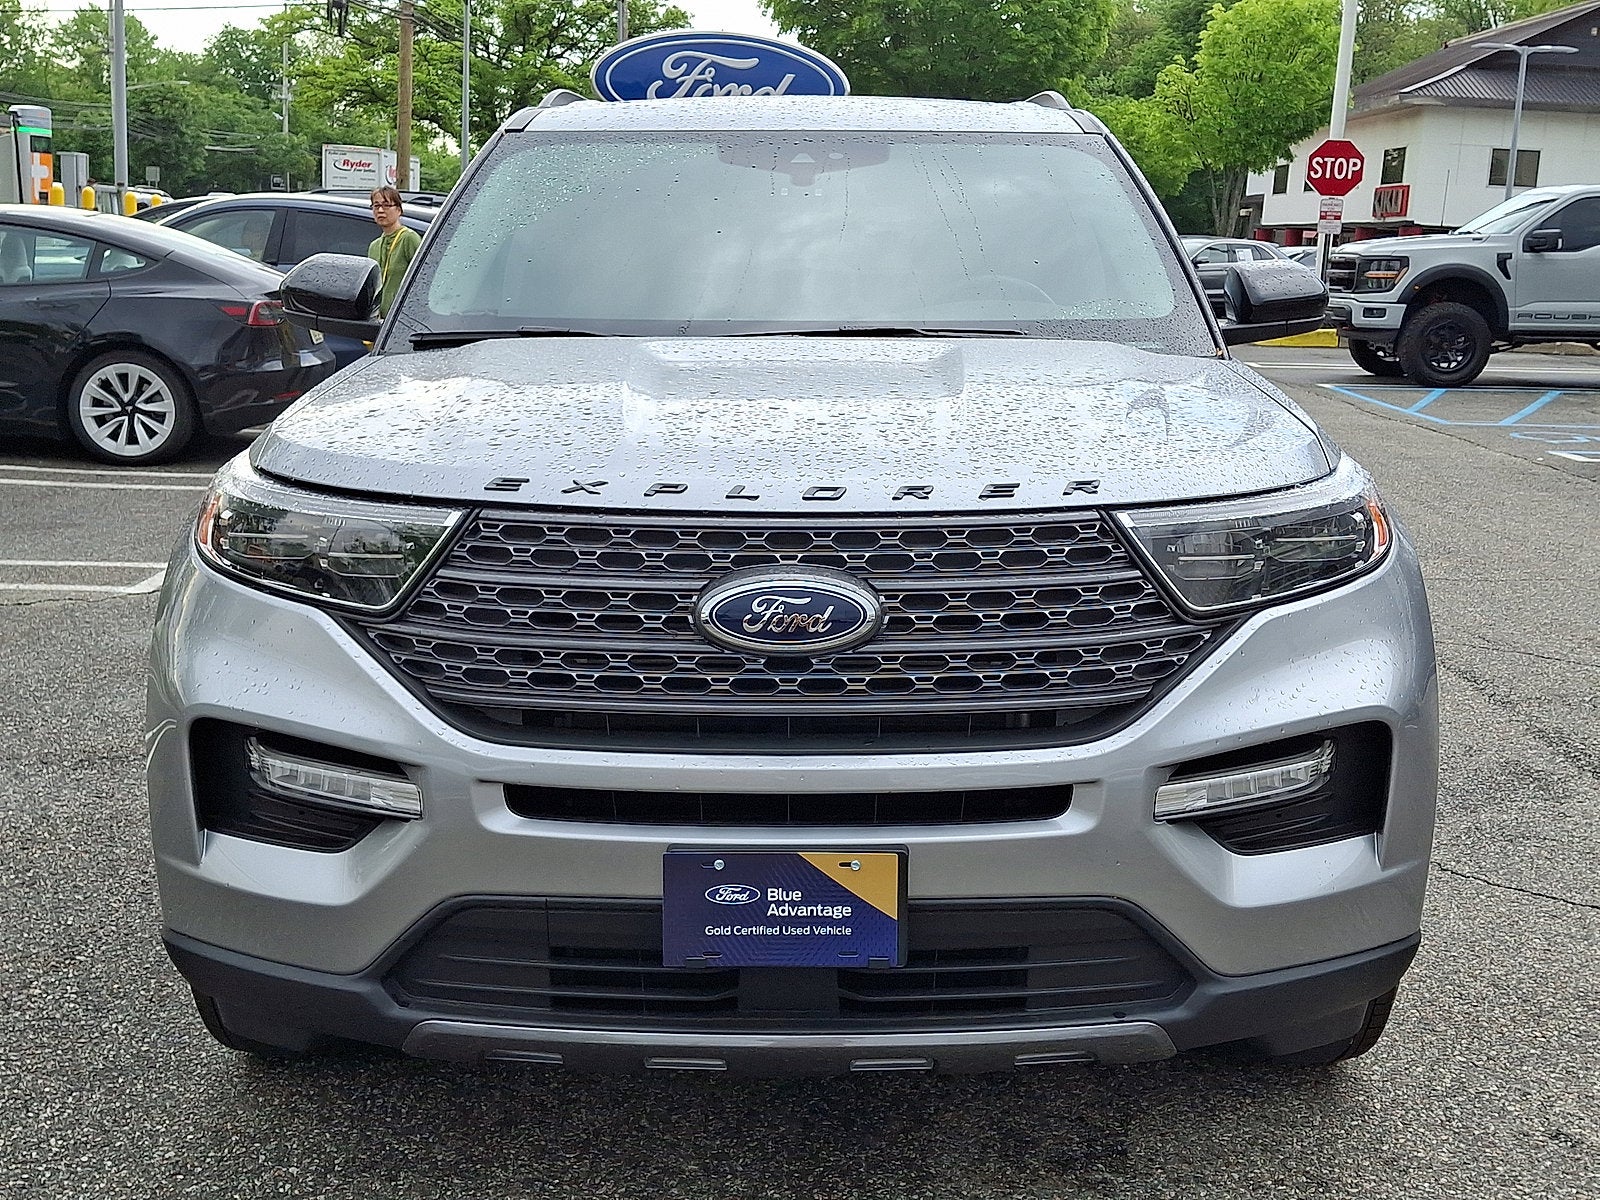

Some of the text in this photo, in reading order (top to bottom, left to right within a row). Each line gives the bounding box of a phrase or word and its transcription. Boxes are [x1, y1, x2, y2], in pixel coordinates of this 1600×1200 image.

[342, 158, 373, 169] Ryder
[1309, 156, 1362, 180] STOP
[484, 476, 1101, 501] EXPLORER
[742, 594, 835, 633] Ford
[715, 887, 751, 901] Ford
[767, 887, 802, 901] Blue
[767, 902, 852, 919] Advantage
[704, 925, 852, 936] Gold Certified Used Vehicle
